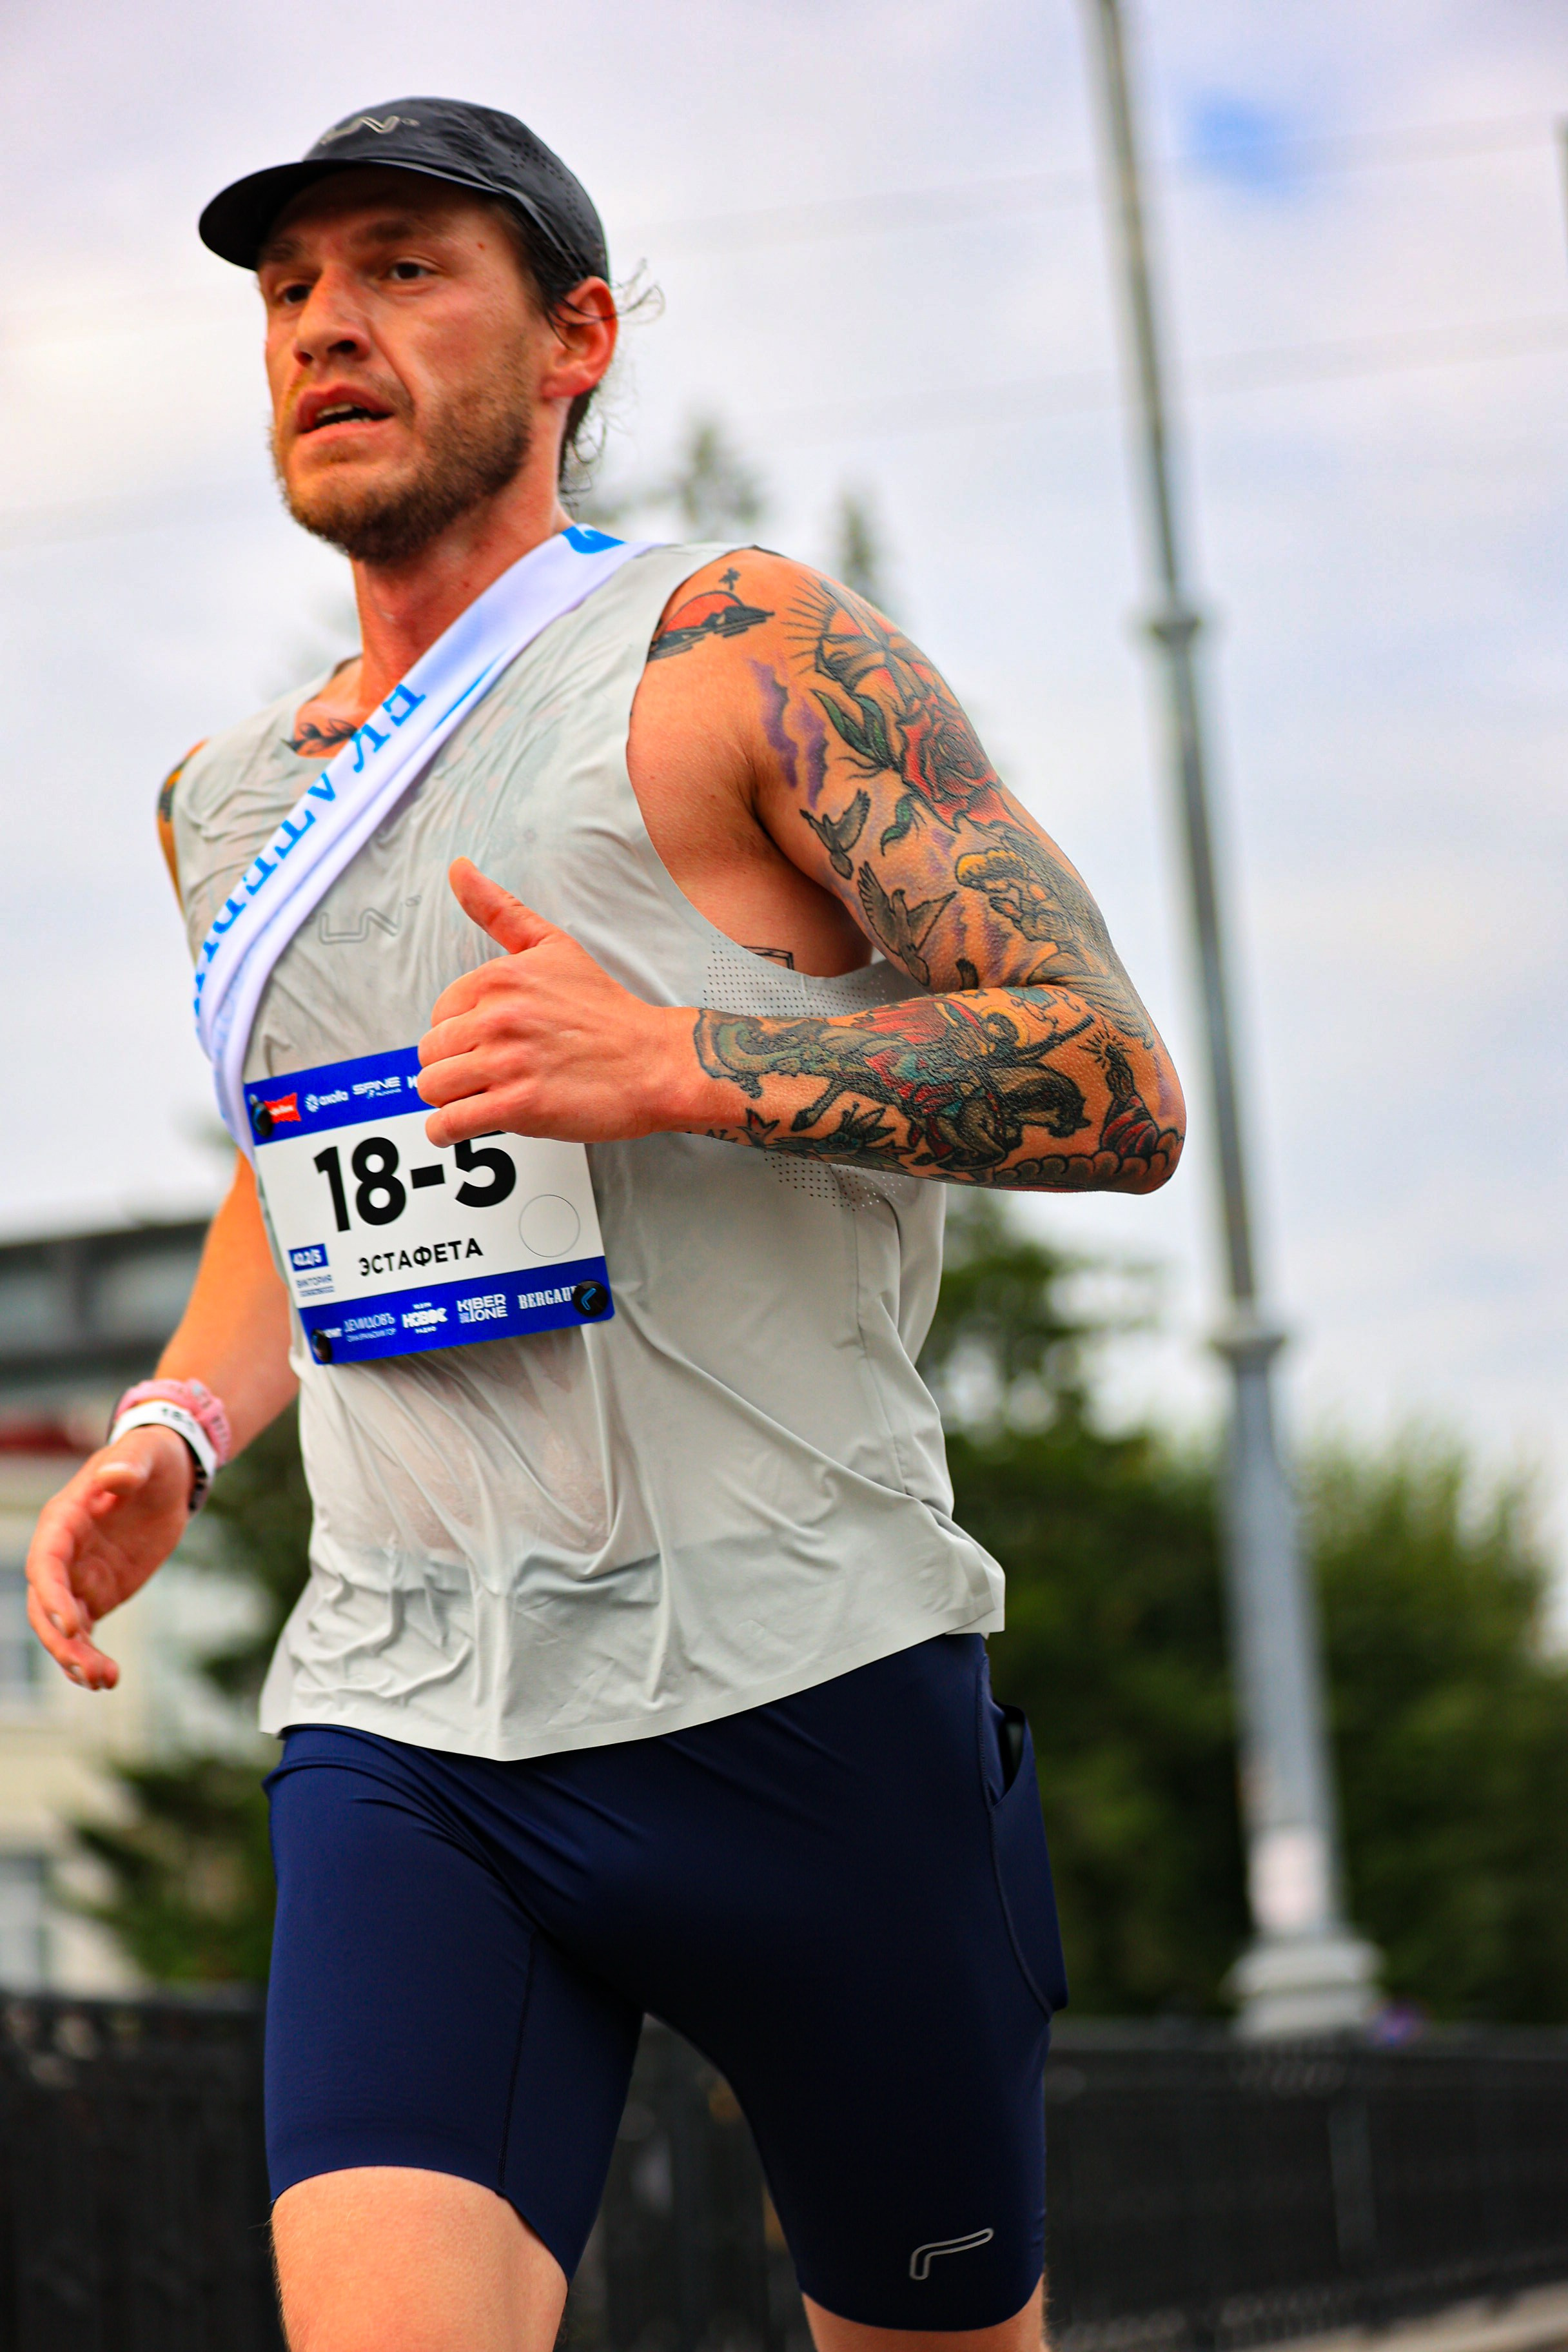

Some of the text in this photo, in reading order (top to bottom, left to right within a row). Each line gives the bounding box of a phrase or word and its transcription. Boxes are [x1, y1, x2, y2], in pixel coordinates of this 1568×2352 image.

[313, 1130, 517, 1232] 18-5
[358, 1238, 484, 1277] ЭСТАФЕТА
[456, 1293, 507, 1313] KIBER
[475, 1306, 509, 1322] ONE
